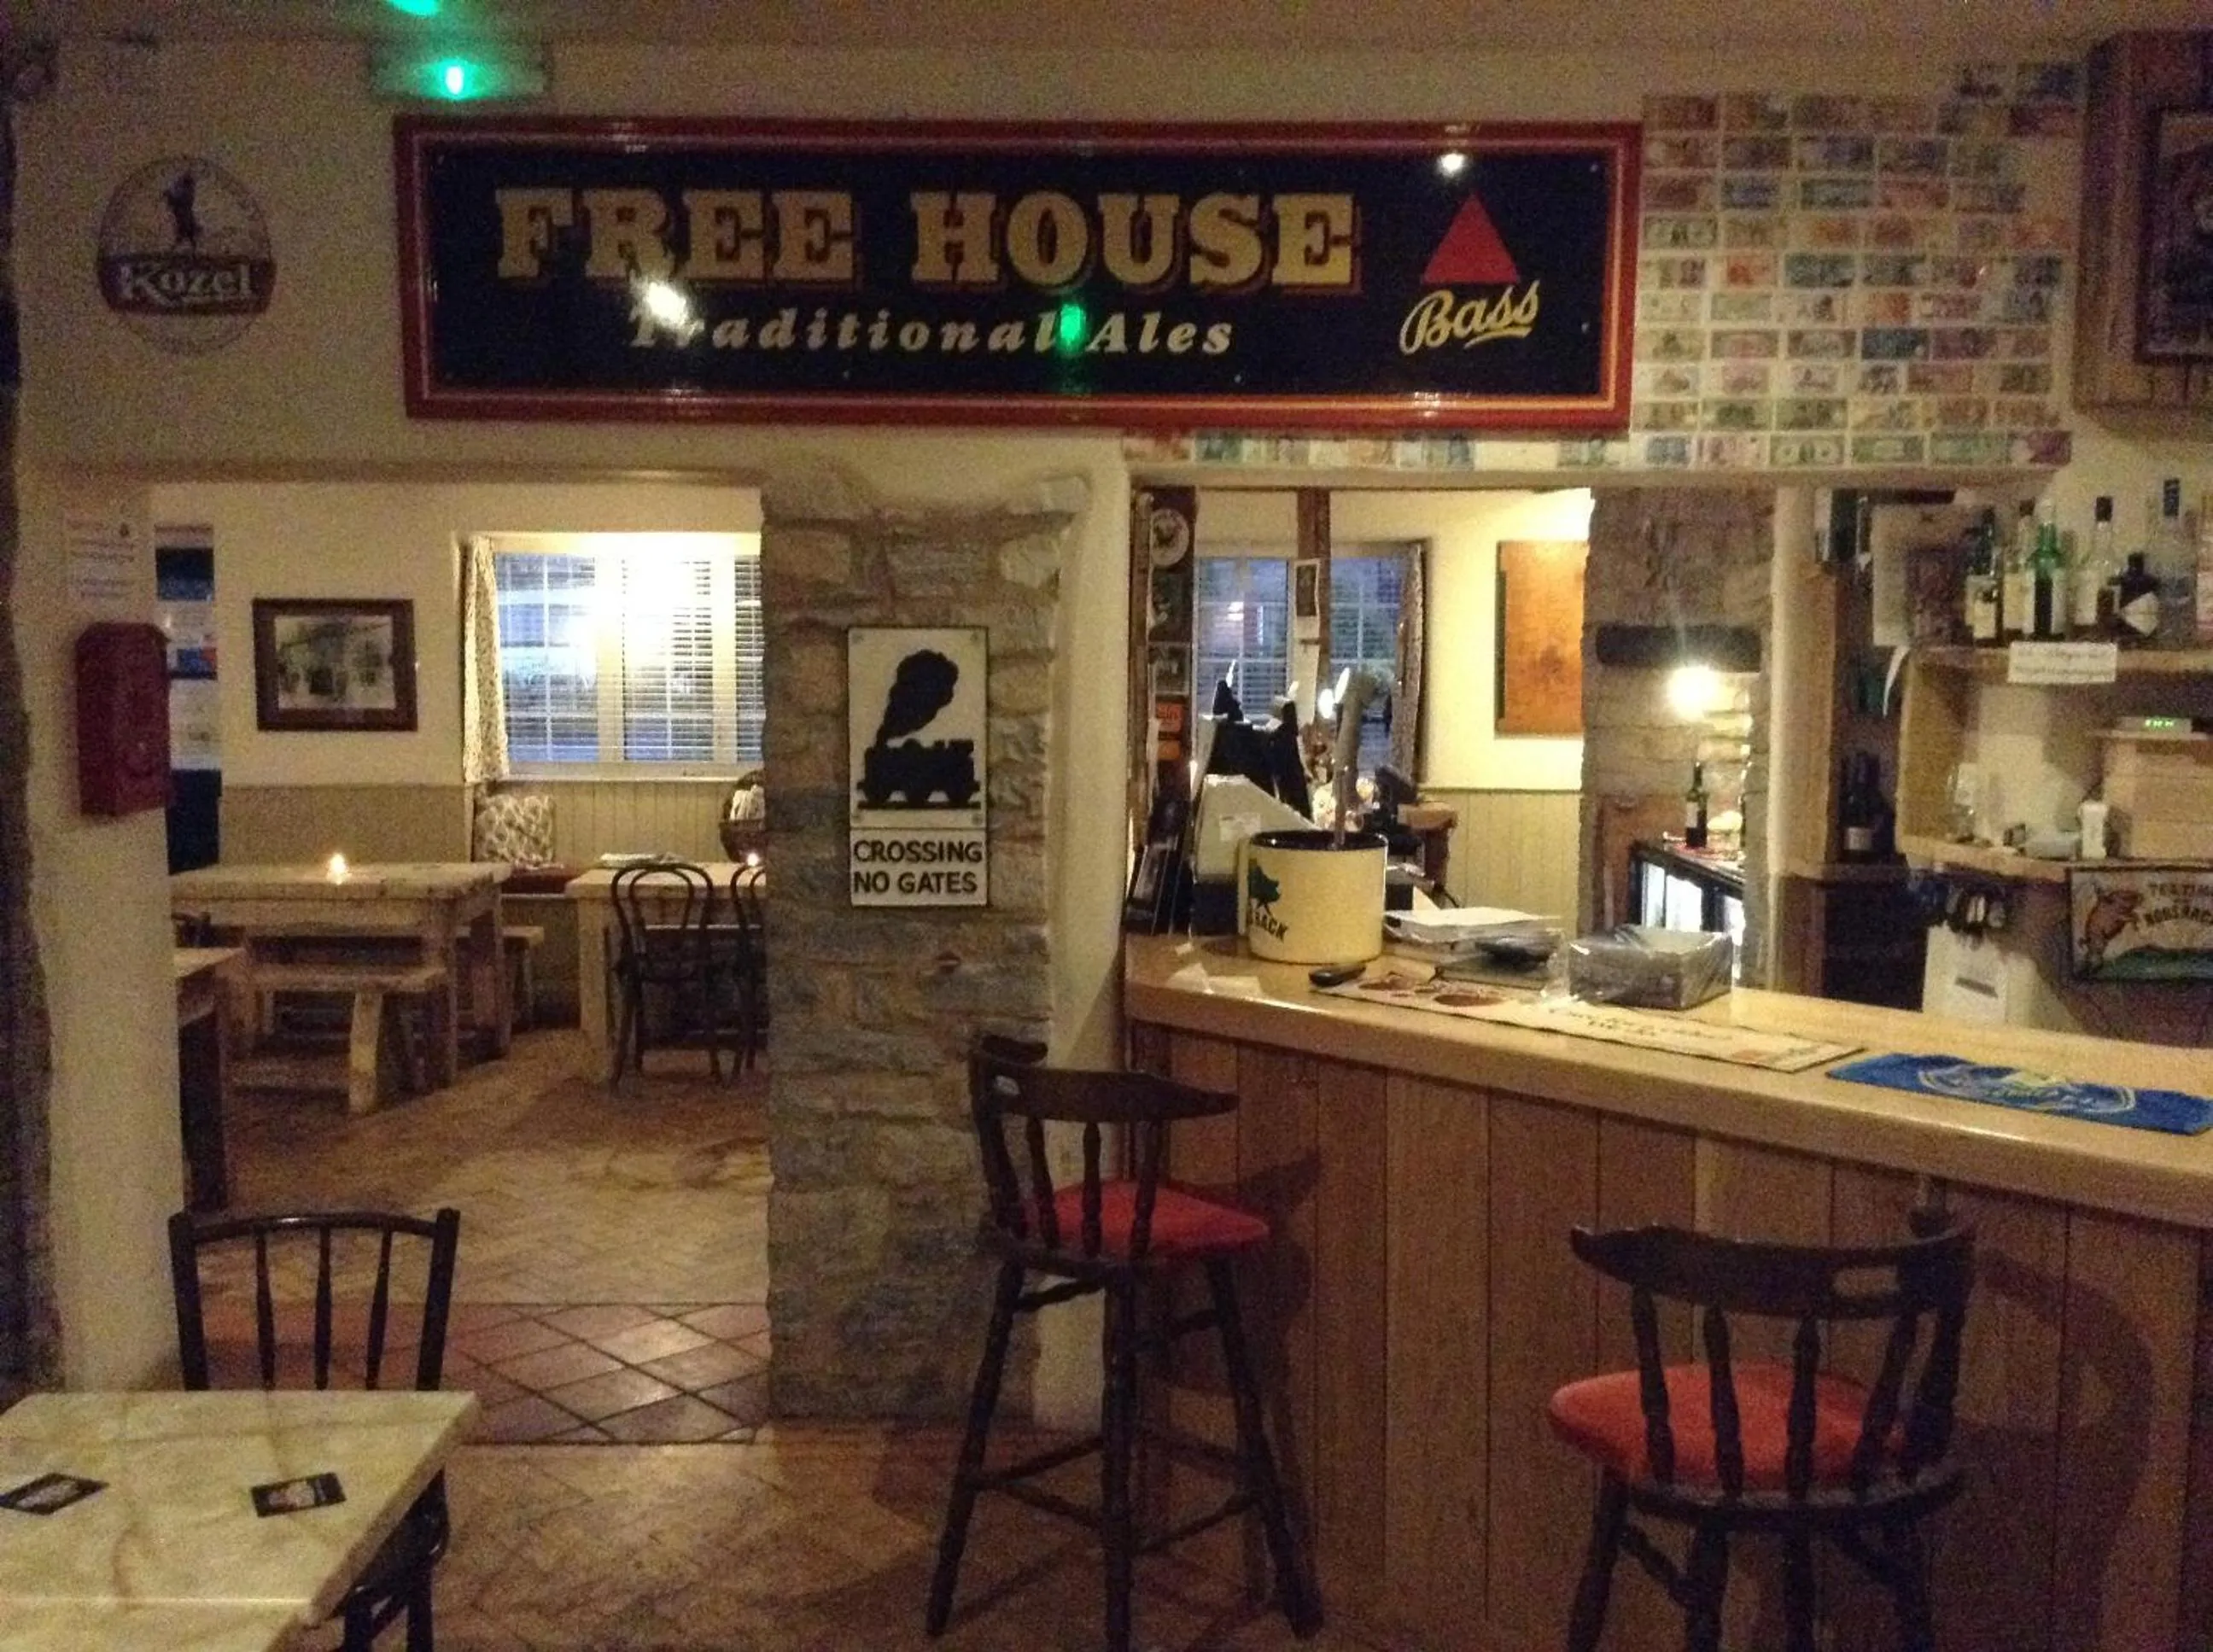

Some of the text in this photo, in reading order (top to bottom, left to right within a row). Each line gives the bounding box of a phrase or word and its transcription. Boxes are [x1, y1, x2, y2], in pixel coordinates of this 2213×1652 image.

[495, 187, 1359, 291] FREE HOUSE
[119, 261, 252, 307] Kozel
[628, 307, 1232, 354] Traditional Ales
[1398, 279, 1539, 355] Bass
[854, 839, 982, 863] CROSSING
[854, 870, 978, 894] NO GATES
